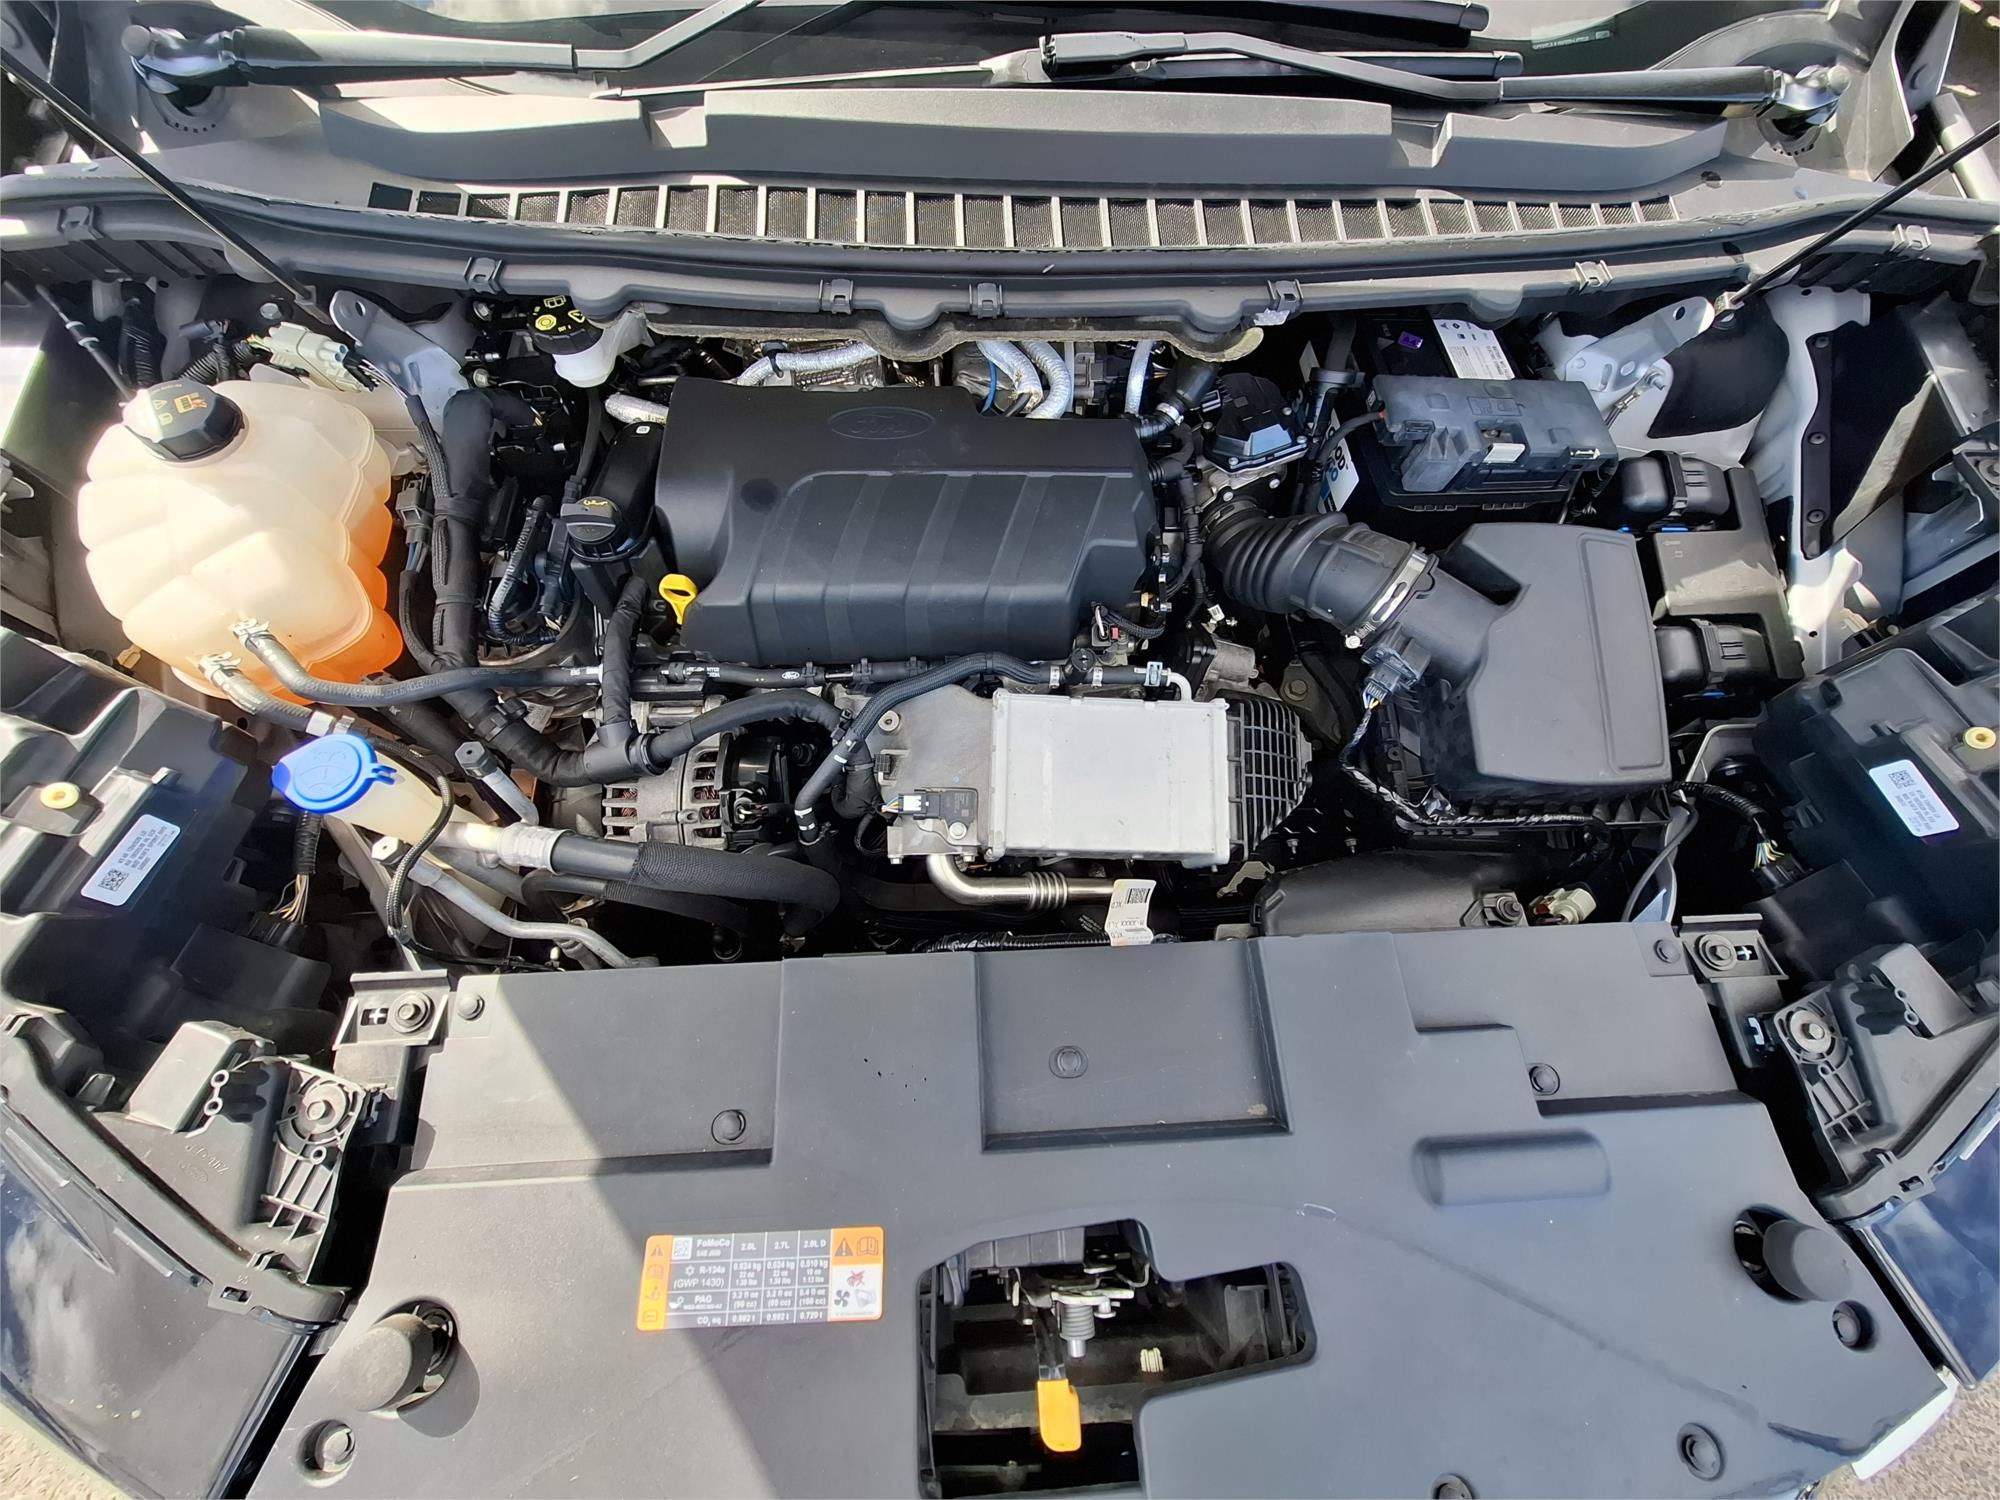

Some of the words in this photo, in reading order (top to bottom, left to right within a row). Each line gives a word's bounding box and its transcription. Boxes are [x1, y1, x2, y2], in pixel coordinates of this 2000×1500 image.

[696, 1238, 731, 1248] FoMoCo
[774, 1241, 790, 1249] 2.7L
[699, 1264, 726, 1274] R-134a
[819, 1259, 829, 1269] kg
[673, 1278, 699, 1289] (GWP
[701, 1277, 725, 1288] 1430)
[746, 1299, 758, 1309] cc)
[780, 1298, 792, 1307] cc)
[815, 1297, 826, 1305] cc)
